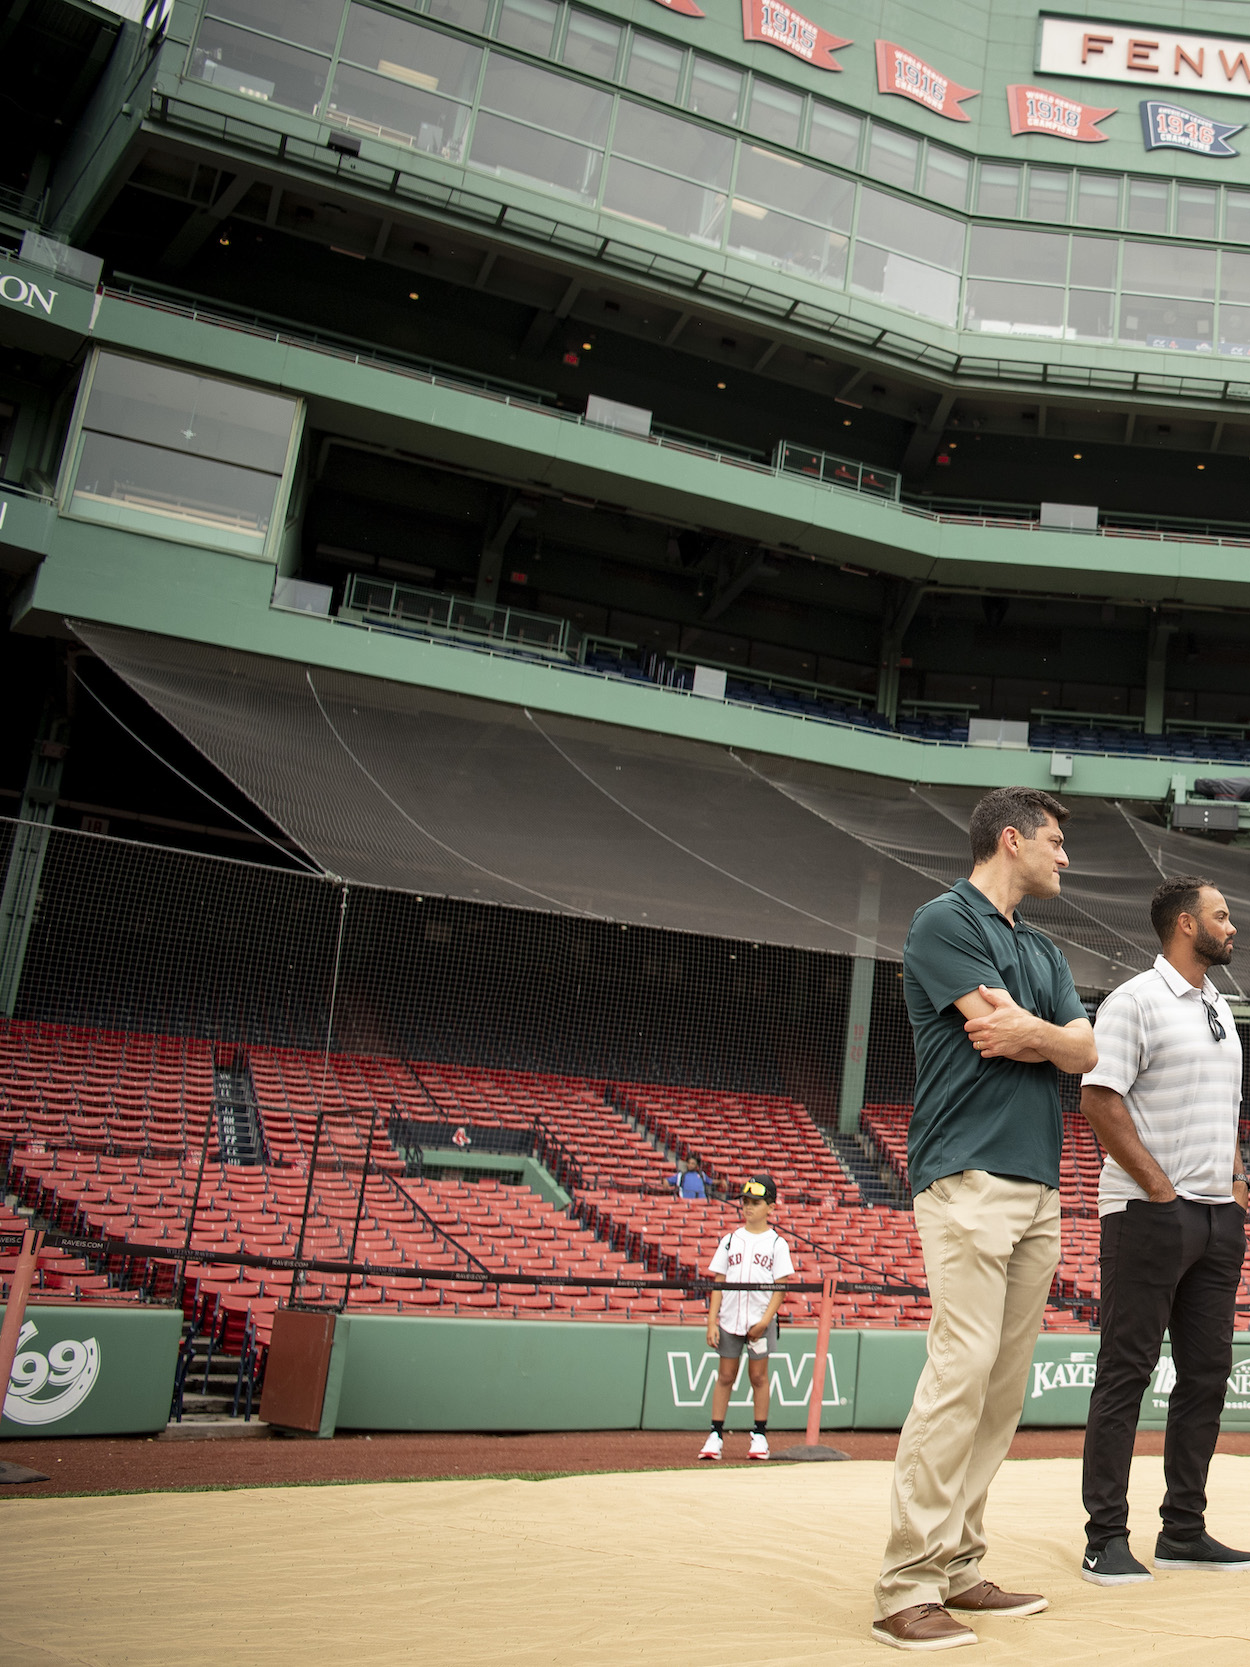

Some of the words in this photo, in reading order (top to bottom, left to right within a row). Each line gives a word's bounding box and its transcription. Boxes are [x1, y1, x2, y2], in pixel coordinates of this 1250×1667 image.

[761, 6, 817, 49] 1915
[761, 26, 813, 59] CHAMPIONS
[895, 60, 947, 101] 1916
[895, 80, 944, 111] CHAMPIONS
[1026, 99, 1081, 128] 1918
[1027, 117, 1078, 137] CHAMPIONS
[1156, 113, 1215, 144] 1946
[0, 275, 59, 315] ON
[61, 1239, 104, 1249] RAVEIS.COM
[272, 1260, 309, 1268] RAVEIS.COM
[1031, 1362, 1097, 1398] KAYE
